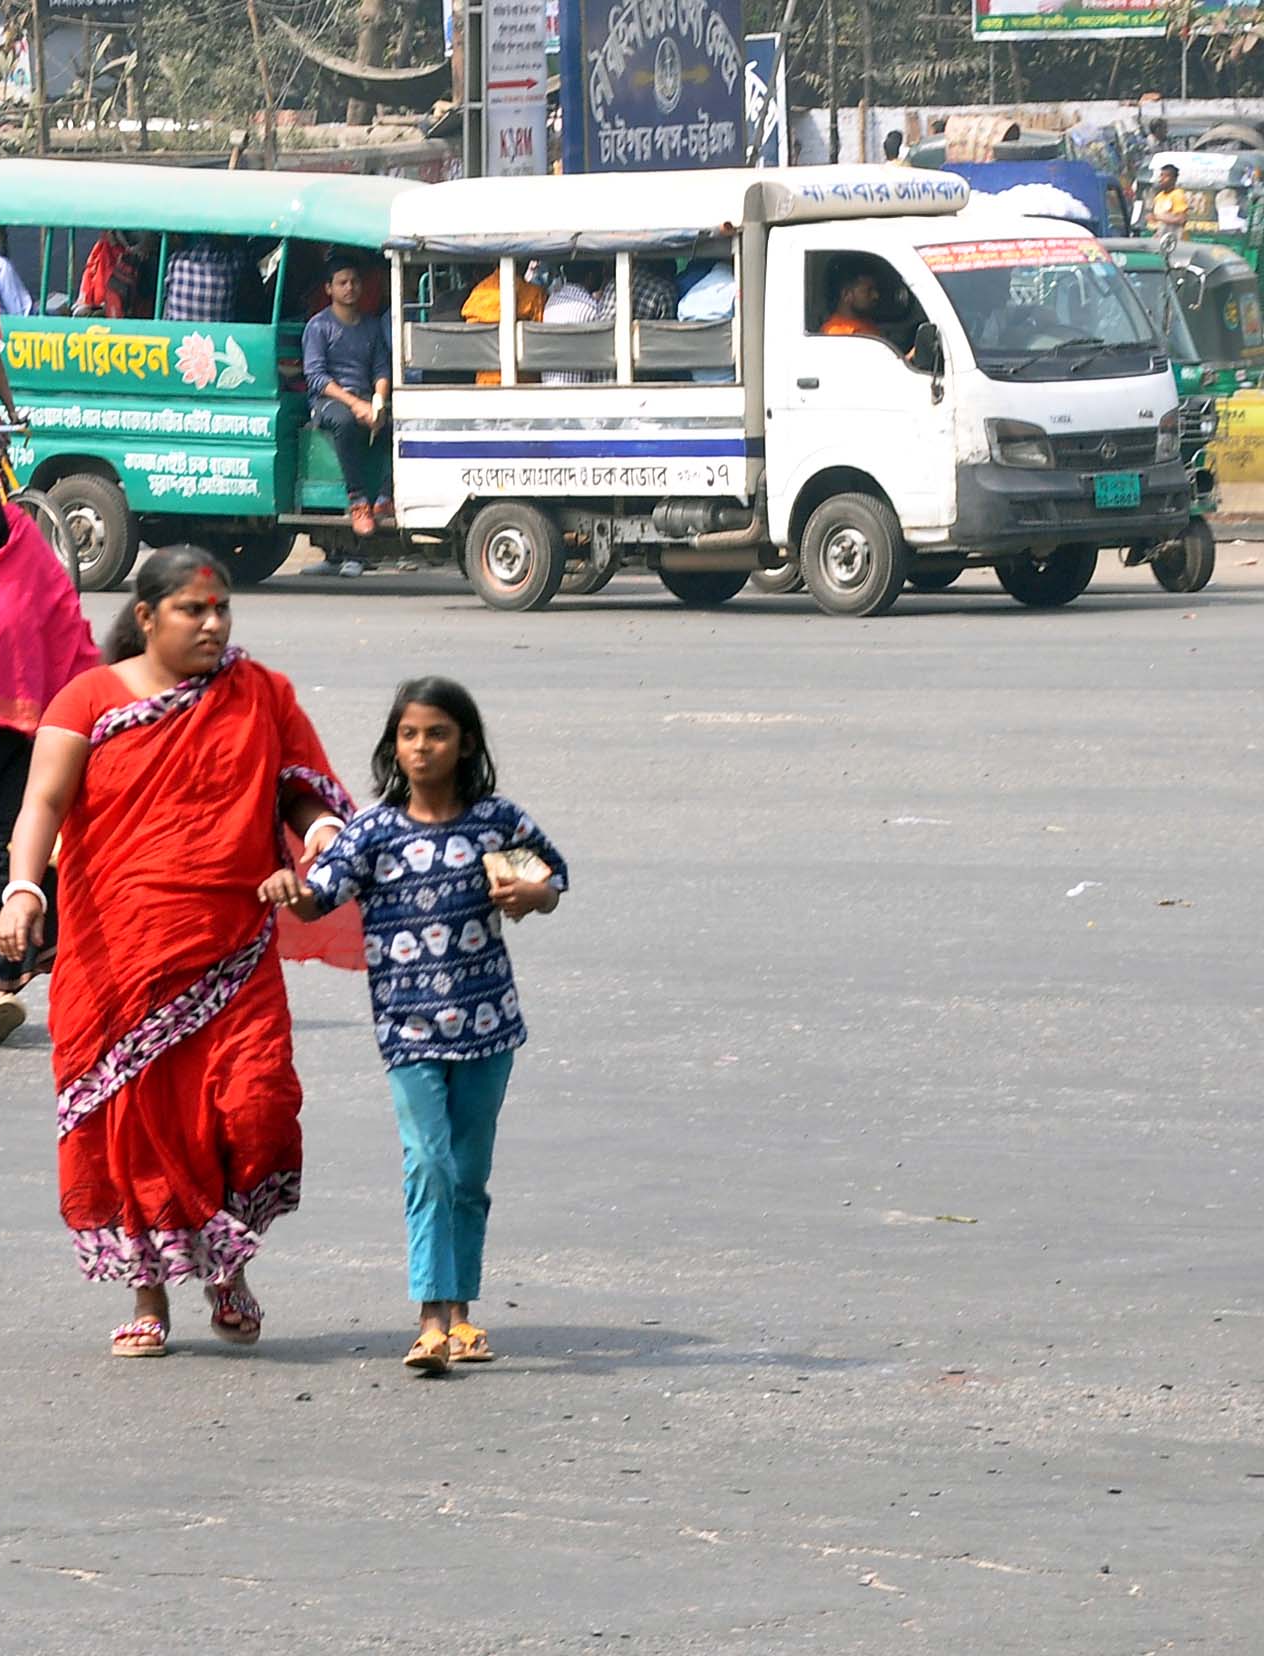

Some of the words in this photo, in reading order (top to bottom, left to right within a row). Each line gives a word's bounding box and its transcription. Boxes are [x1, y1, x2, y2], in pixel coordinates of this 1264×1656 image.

[6, 331, 66, 371] আশা
[67, 324, 171, 379] পরিবহন
[519, 467, 576, 486] আগ্রাবাদ
[706, 464, 730, 487] ১৭
